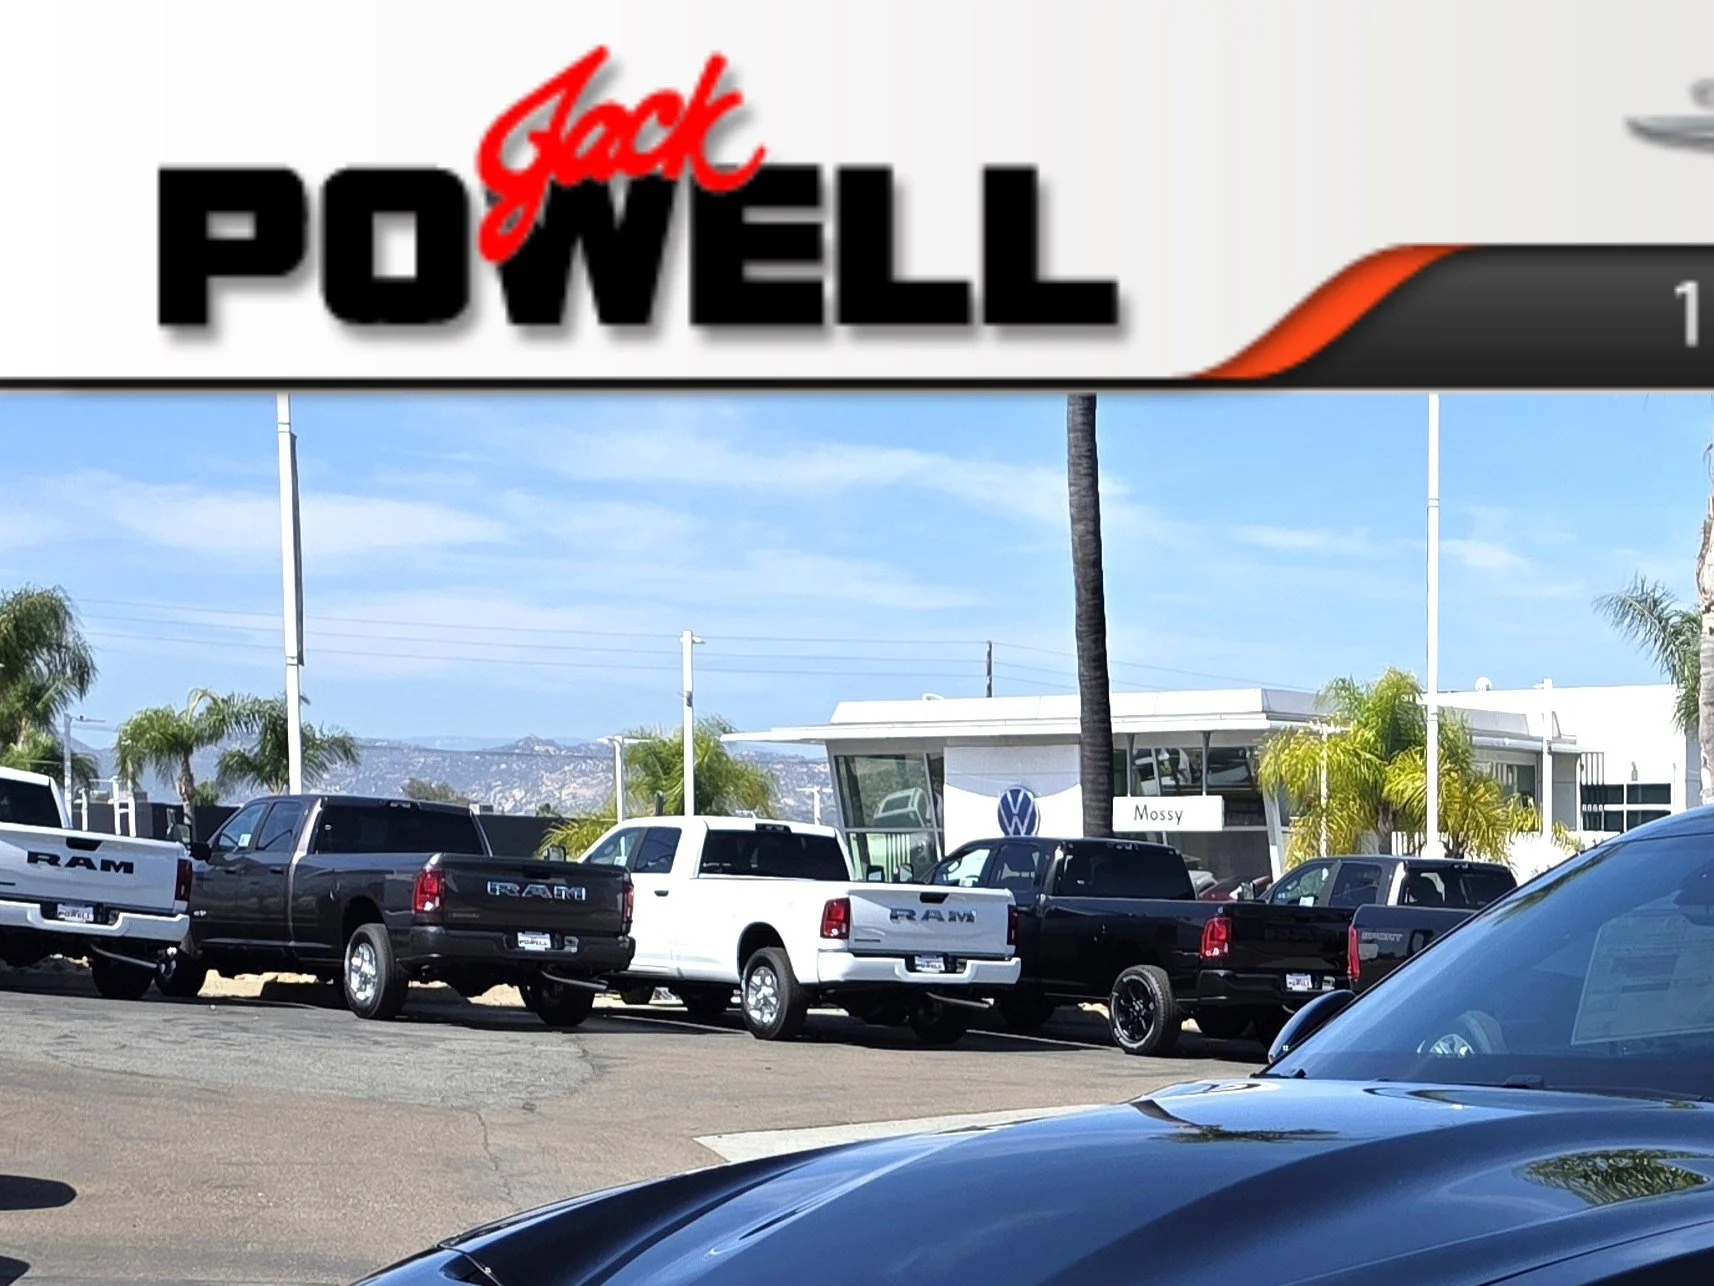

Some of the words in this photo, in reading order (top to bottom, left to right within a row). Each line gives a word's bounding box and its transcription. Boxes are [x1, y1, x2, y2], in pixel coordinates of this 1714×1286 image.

[1133, 804, 1184, 826] Mossy
[27, 851, 134, 875] RAM
[487, 881, 586, 901] RAM
[889, 907, 977, 924] RAM
